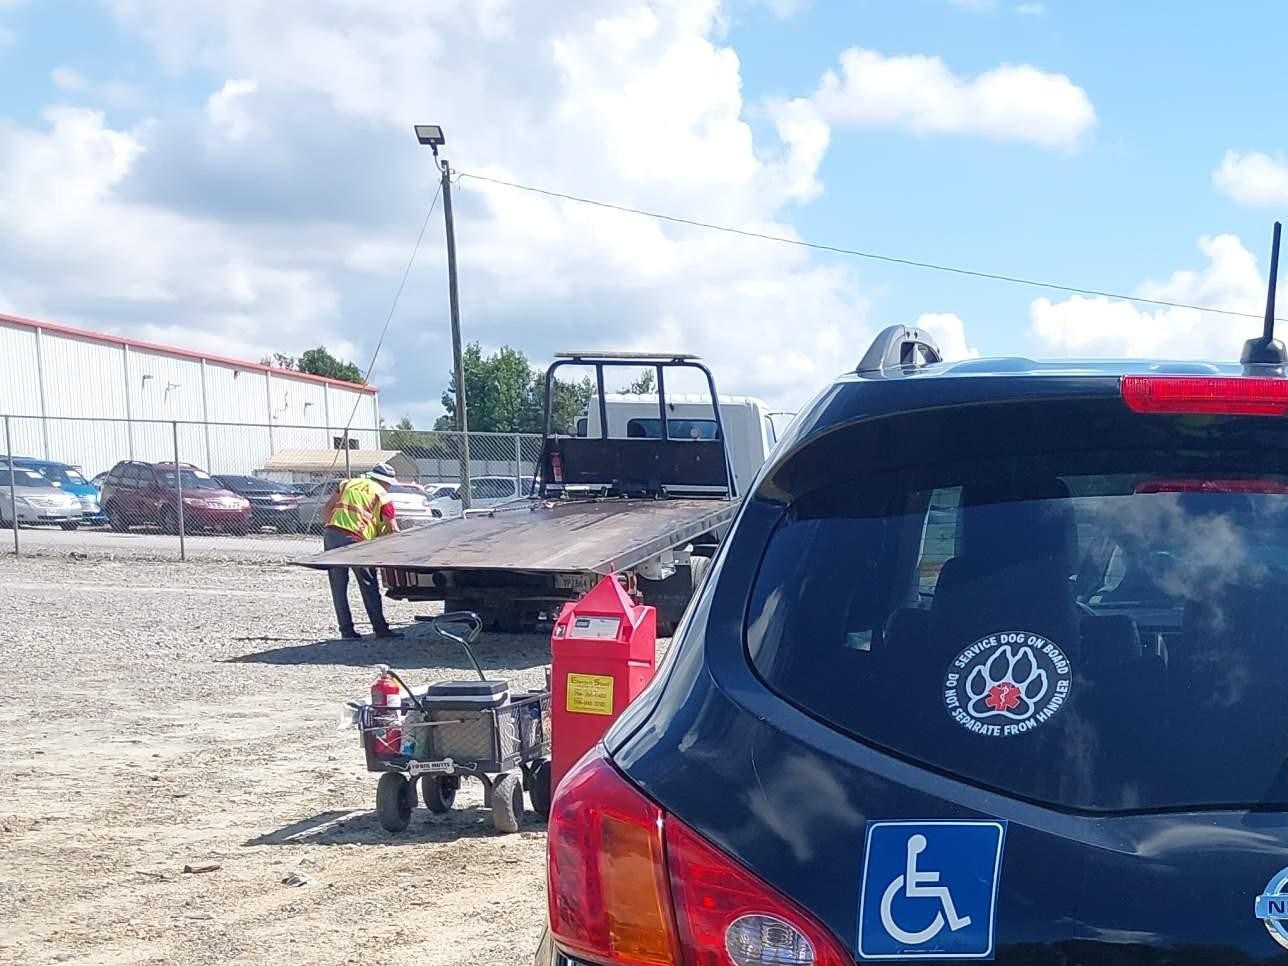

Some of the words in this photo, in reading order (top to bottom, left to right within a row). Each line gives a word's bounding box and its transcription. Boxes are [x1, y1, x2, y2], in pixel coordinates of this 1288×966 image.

[955, 636, 998, 669] SERVICE
[1000, 633, 1025, 644] DOG
[1027, 636, 1046, 649] ON
[1042, 643, 1069, 675] BOARD
[946, 673, 960, 688] DO
[944, 688, 960, 709] NOT
[1036, 680, 1069, 723] HANDLER
[951, 707, 1002, 736] SEPARATE
[1003, 718, 1037, 736] FROM
